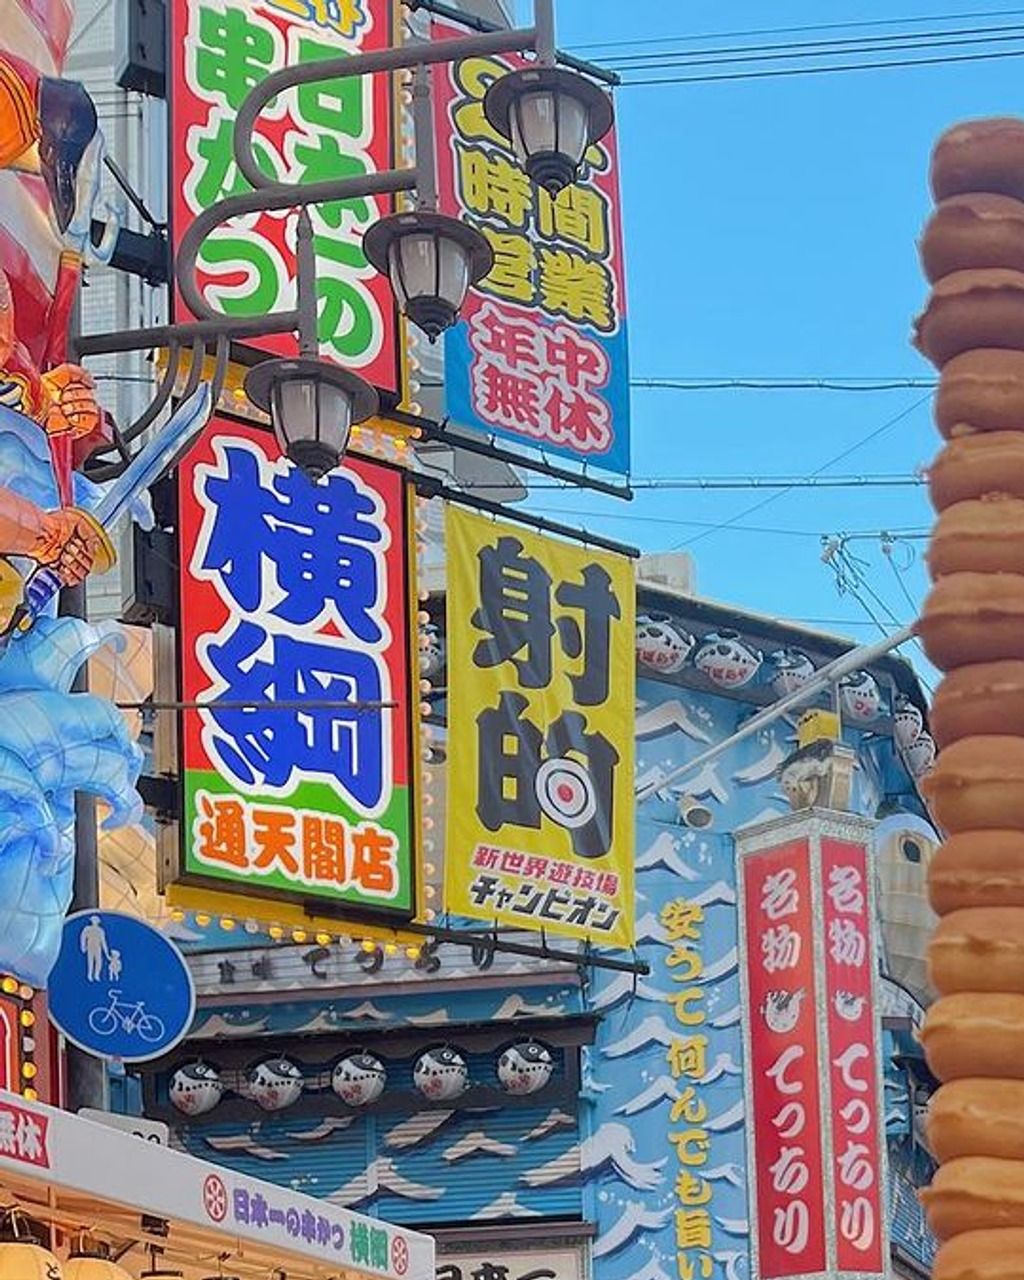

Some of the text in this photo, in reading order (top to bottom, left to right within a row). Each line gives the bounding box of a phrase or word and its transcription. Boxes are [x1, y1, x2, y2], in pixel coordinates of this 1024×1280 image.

[484, 310, 600, 388] 年中
[485, 364, 604, 442] 無休
[201, 446, 383, 808] 横綱
[472, 536, 621, 858] 射的
[198, 797, 396, 894] 通天閣店
[472, 844, 619, 897] 新世界遊技場
[471, 873, 620, 931] チャンピオン
[765, 1043, 810, 1256] てっちり
[831, 1041, 876, 1250] てっちり
